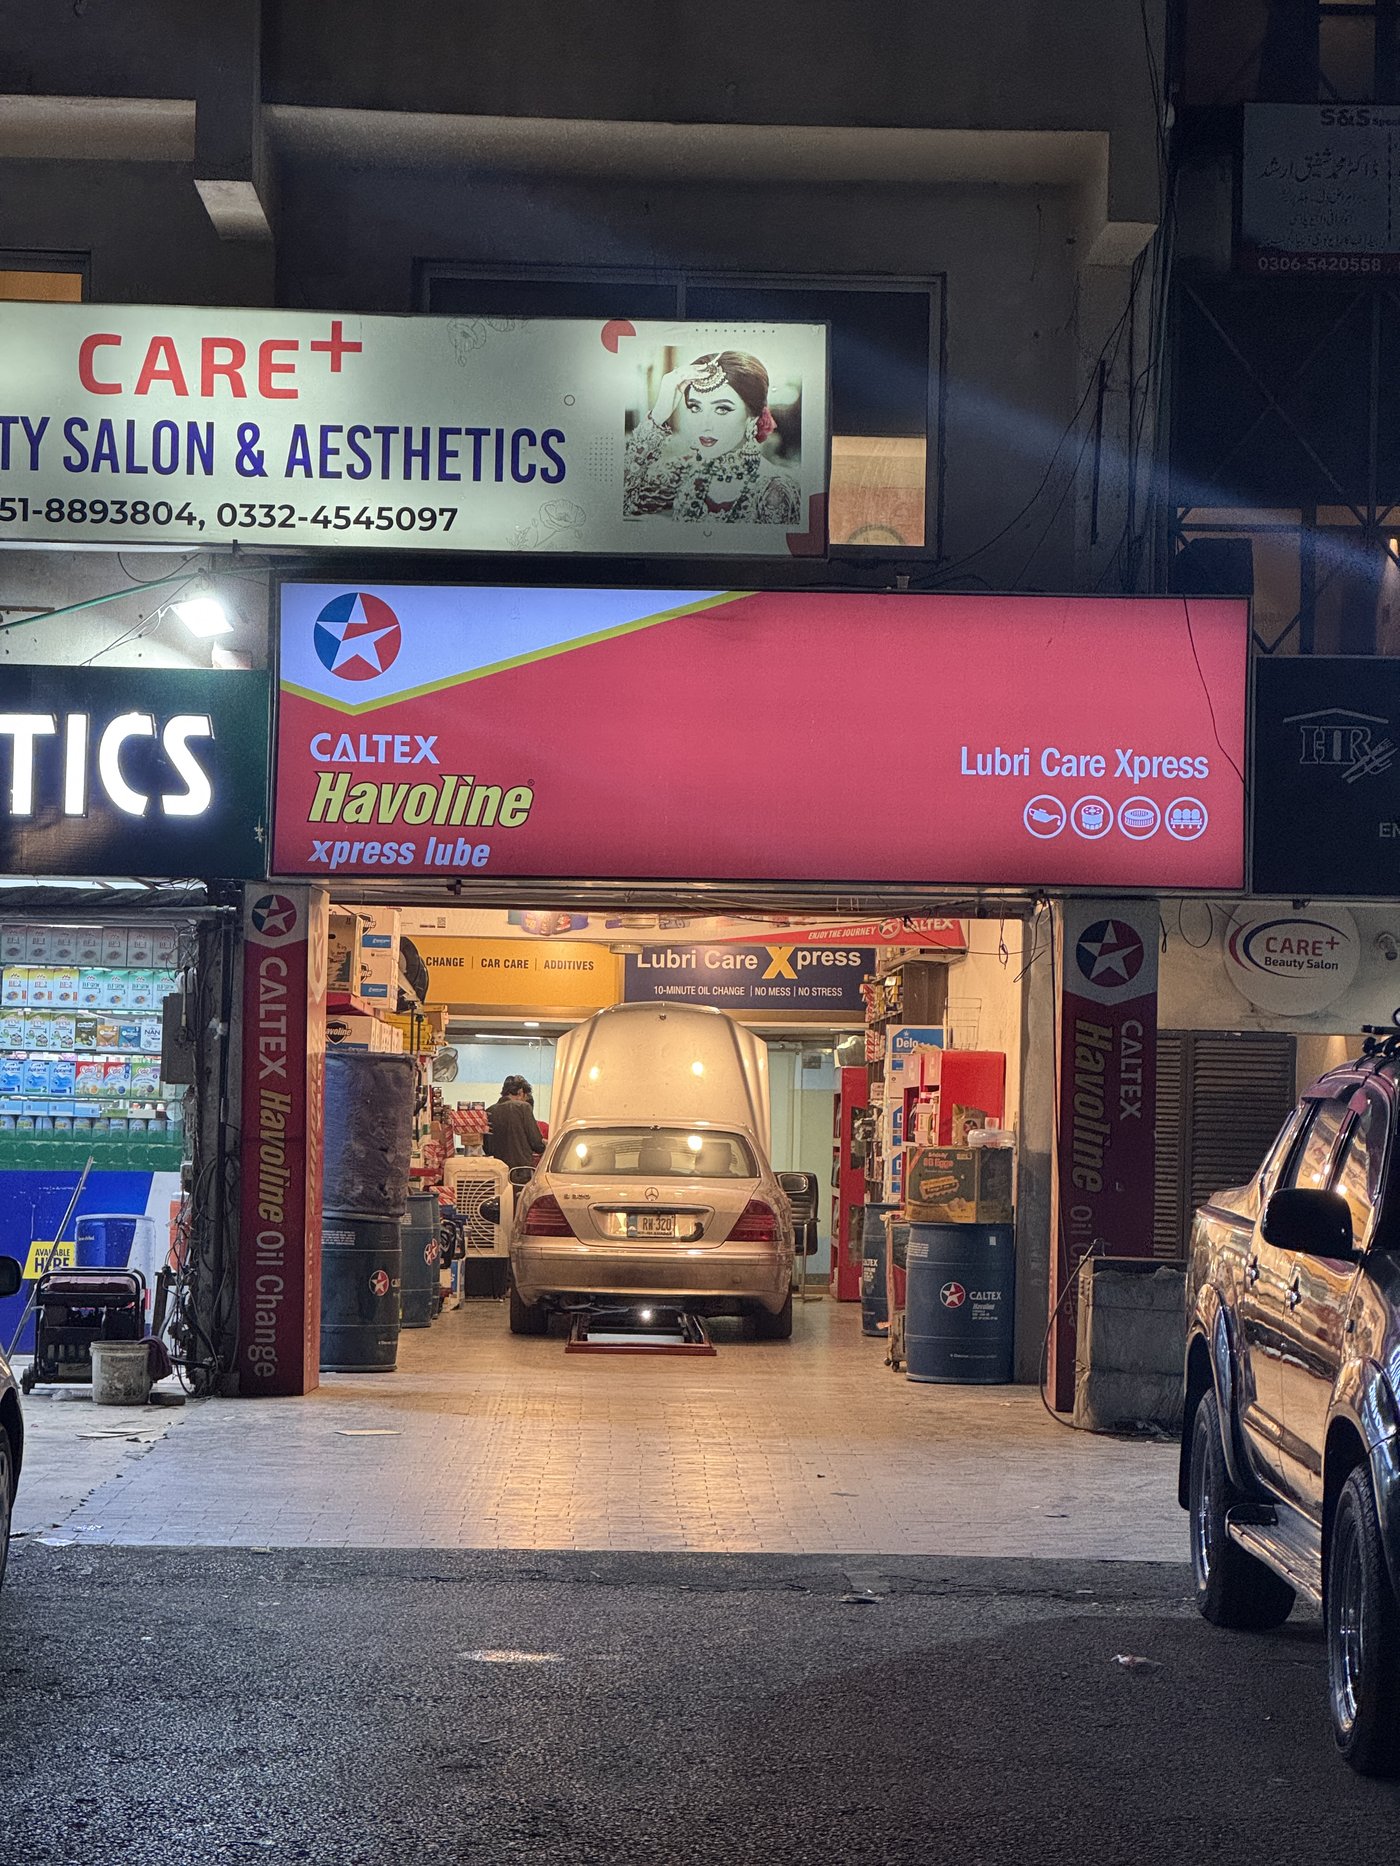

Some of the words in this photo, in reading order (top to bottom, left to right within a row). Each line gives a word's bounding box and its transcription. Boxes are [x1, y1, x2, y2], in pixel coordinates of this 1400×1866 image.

[78, 320, 362, 399] CARE+
[63, 416, 215, 476] SALON
[235, 423, 269, 478] &
[285, 424, 567, 484] AESTHETICS
[216, 502, 459, 532] 0332-4545097
[0, 712, 215, 816] TICS
[310, 732, 440, 765] CALTEX
[961, 747, 1030, 776] Lubri
[1040, 747, 1106, 777] Care
[1113, 749, 1209, 784] Xpress
[307, 771, 535, 828] Havoline
[307, 840, 416, 870] xpress
[424, 837, 491, 867] lube
[828, 929, 842, 938] THE
[842, 926, 876, 937] JOURNEY
[426, 956, 465, 968] CHANGE
[480, 958, 501, 969] CAR
[503, 959, 529, 970] CARE
[543, 960, 594, 971] ADDITIVES
[636, 948, 696, 969] Lubri
[704, 950, 758, 970] Care
[1264, 956, 1304, 970] Beauty
[1306, 959, 1339, 970] Salon
[653, 985, 696, 996] 10-MINUTE
[698, 986, 711, 997] OIL
[712, 986, 745, 997] CHANGE
[754, 986, 766, 997] NO
[768, 986, 791, 997] MESS
[798, 987, 810, 997] NO
[812, 987, 843, 997] STRESS
[259, 956, 288, 1080] CALTEX
[1120, 1019, 1144, 1121] CALTEX
[1072, 1018, 1113, 1193] Havoline
[258, 1088, 292, 1224] Havoline
[1070, 1205, 1092, 1235] Oil
[256, 1231, 285, 1266] Oil
[970, 1291, 1001, 1300] CALTEX
[248, 1274, 284, 1377] Change
